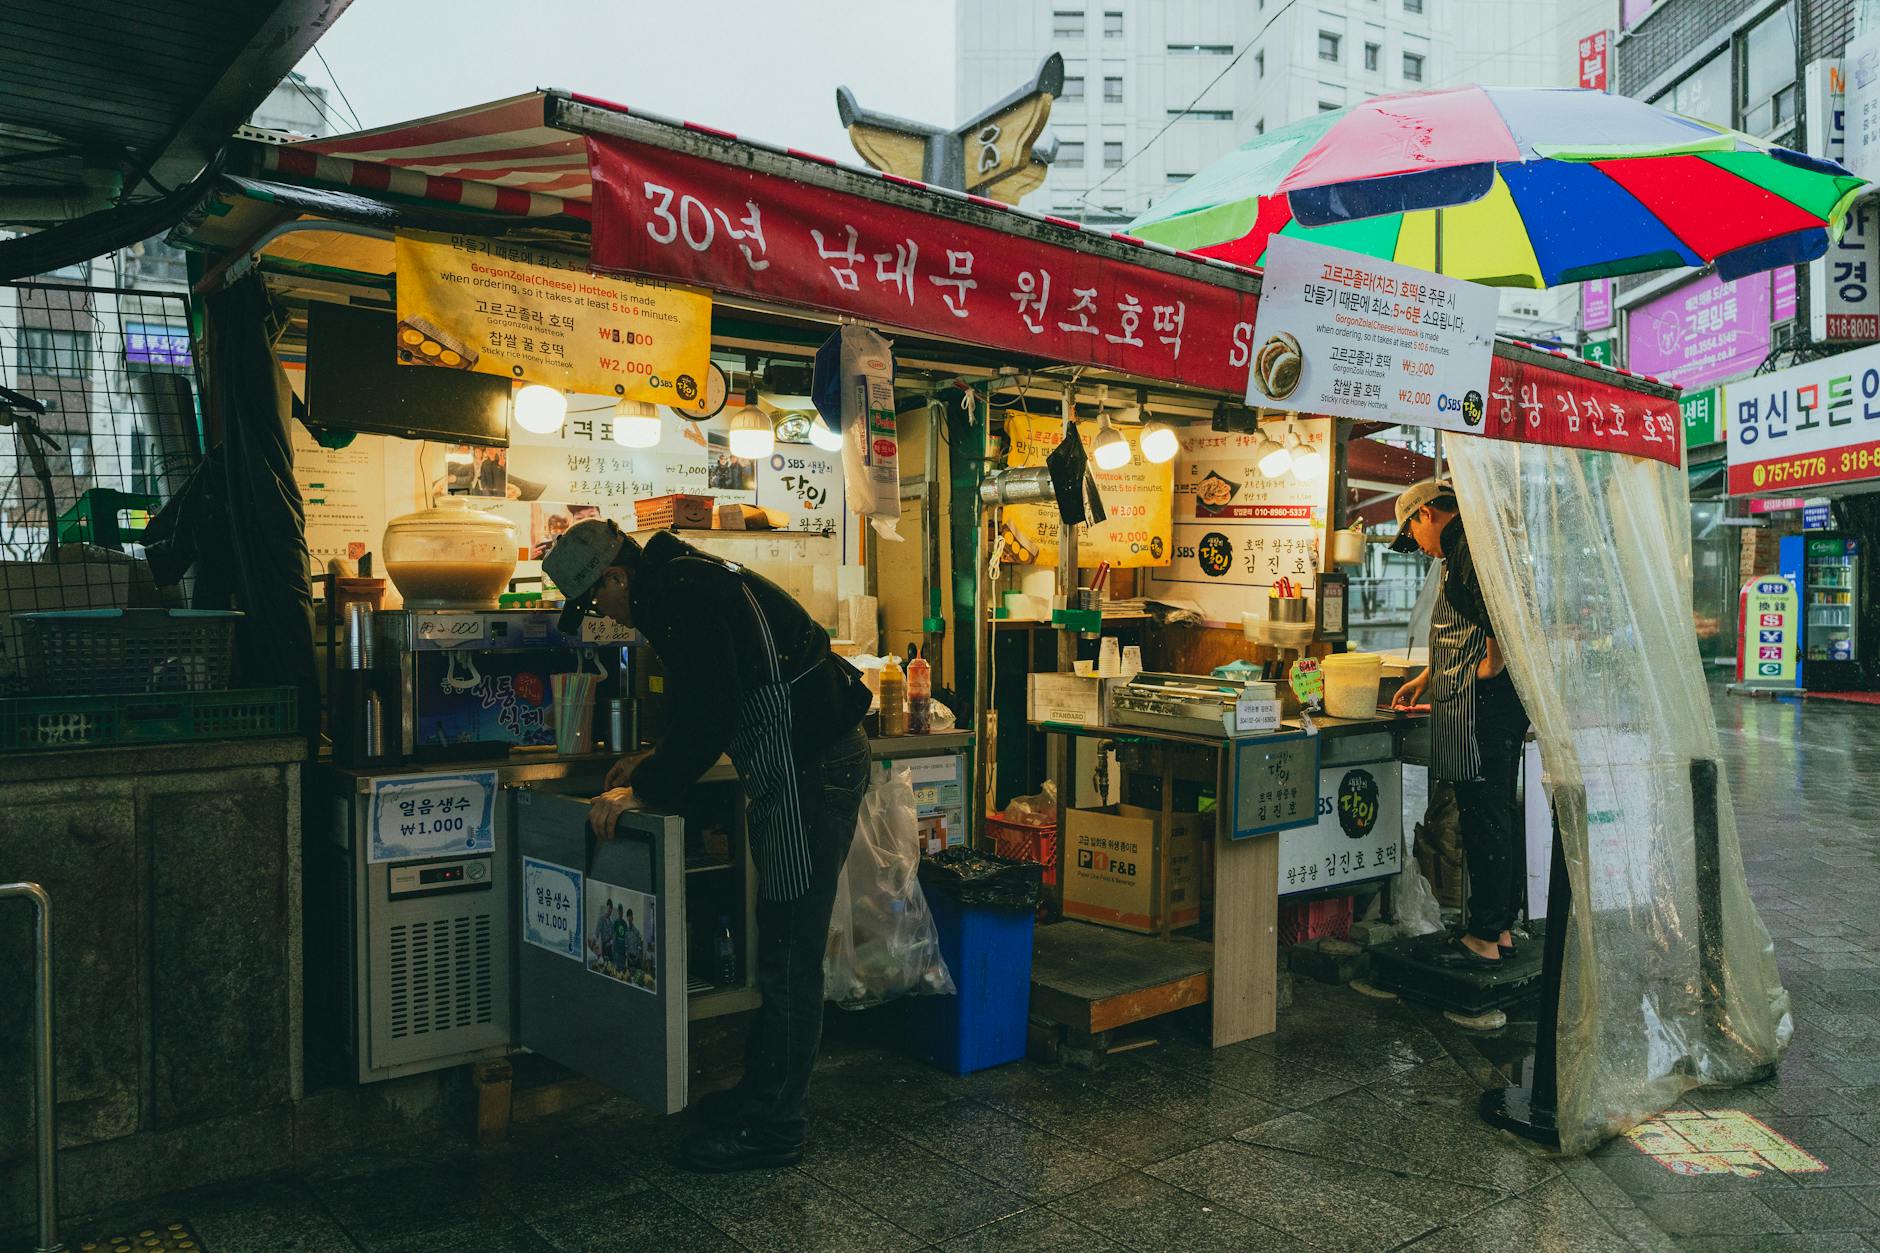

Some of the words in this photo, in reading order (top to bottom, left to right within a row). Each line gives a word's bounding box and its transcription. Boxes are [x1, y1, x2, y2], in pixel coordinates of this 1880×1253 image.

[452, 235, 490, 256] 만들기
[495, 245, 533, 266] 때문에
[643, 181, 770, 271] 30년
[810, 224, 978, 318] 남대문
[1009, 268, 1186, 361] 원조호떡
[471, 263, 576, 292] GorgonZola(Cheese)
[579, 284, 618, 300] Hotteok
[620, 292, 628, 301] is
[630, 295, 656, 307] made
[1320, 263, 1398, 298] 고르곤졸라(치즈)
[1400, 281, 1427, 304] 호떡은
[1428, 288, 1446, 308] 주문
[1447, 292, 1456, 311] 시
[440, 271, 470, 285] when
[473, 276, 520, 295] ordering,
[522, 287, 533, 297] so
[535, 288, 543, 299] it
[545, 290, 572, 304] takes
[574, 295, 585, 306] at
[587, 298, 610, 311] least
[612, 303, 618, 312] 5
[620, 304, 631, 314] to
[633, 306, 639, 316] 6
[641, 308, 681, 323] minutes.
[1303, 283, 1337, 308] 만들기
[1339, 291, 1371, 314] 때문에
[1422, 309, 1465, 334] 소요됩니다.
[474, 300, 544, 326] 고르곤졸라
[547, 313, 574, 332] 호떡
[486, 316, 533, 332] Gorgonzola
[1828, 316, 1877, 338] 318-8005
[489, 330, 517, 349] 찹쌀
[522, 336, 534, 352] 꿀
[538, 341, 565, 358] 호떡
[1316, 324, 1334, 336] when
[1335, 327, 1362, 341] ordering,
[1364, 333, 1371, 341] so
[1372, 334, 1377, 342] it
[1377, 335, 1392, 345] takes
[1393, 339, 1399, 347] at
[481, 345, 505, 358] Sticky
[506, 350, 521, 359] rice
[522, 353, 544, 365] Honey
[545, 358, 574, 369] Hotteok
[599, 357, 653, 375] ₩2,000
[1329, 346, 1374, 367] 고르곤졸라
[1375, 354, 1392, 371] 호떡
[1321, 394, 1338, 405] Sticky
[1333, 378, 1352, 396] 찹쌀
[1353, 381, 1362, 398] 꿀
[1364, 383, 1381, 400] 호떡
[1398, 389, 1431, 405] ₩2,000
[1447, 398, 1462, 411] SBS
[1680, 396, 1709, 428] 센터
[1556, 391, 1630, 437] 김진호
[1642, 408, 1676, 452] 호떡
[787, 458, 805, 469] SBS
[1767, 456, 1827, 482] 757-5776
[1037, 522, 1060, 537] 찹쌀
[1109, 531, 1148, 543] ₩2,000
[1177, 546, 1195, 558] SBS
[1244, 538, 1264, 552] 호떡
[1271, 538, 1307, 554] 왕중왕
[1051, 711, 1084, 721] STANDARD
[400, 797, 471, 817] 얼음생수
[1109, 860, 1137, 876] F&B
[1286, 864, 1319, 885] 왕중왕
[1325, 851, 1365, 877] 김진호
[1373, 842, 1397, 867] 호떡
[536, 887, 570, 912] 얼음생수
